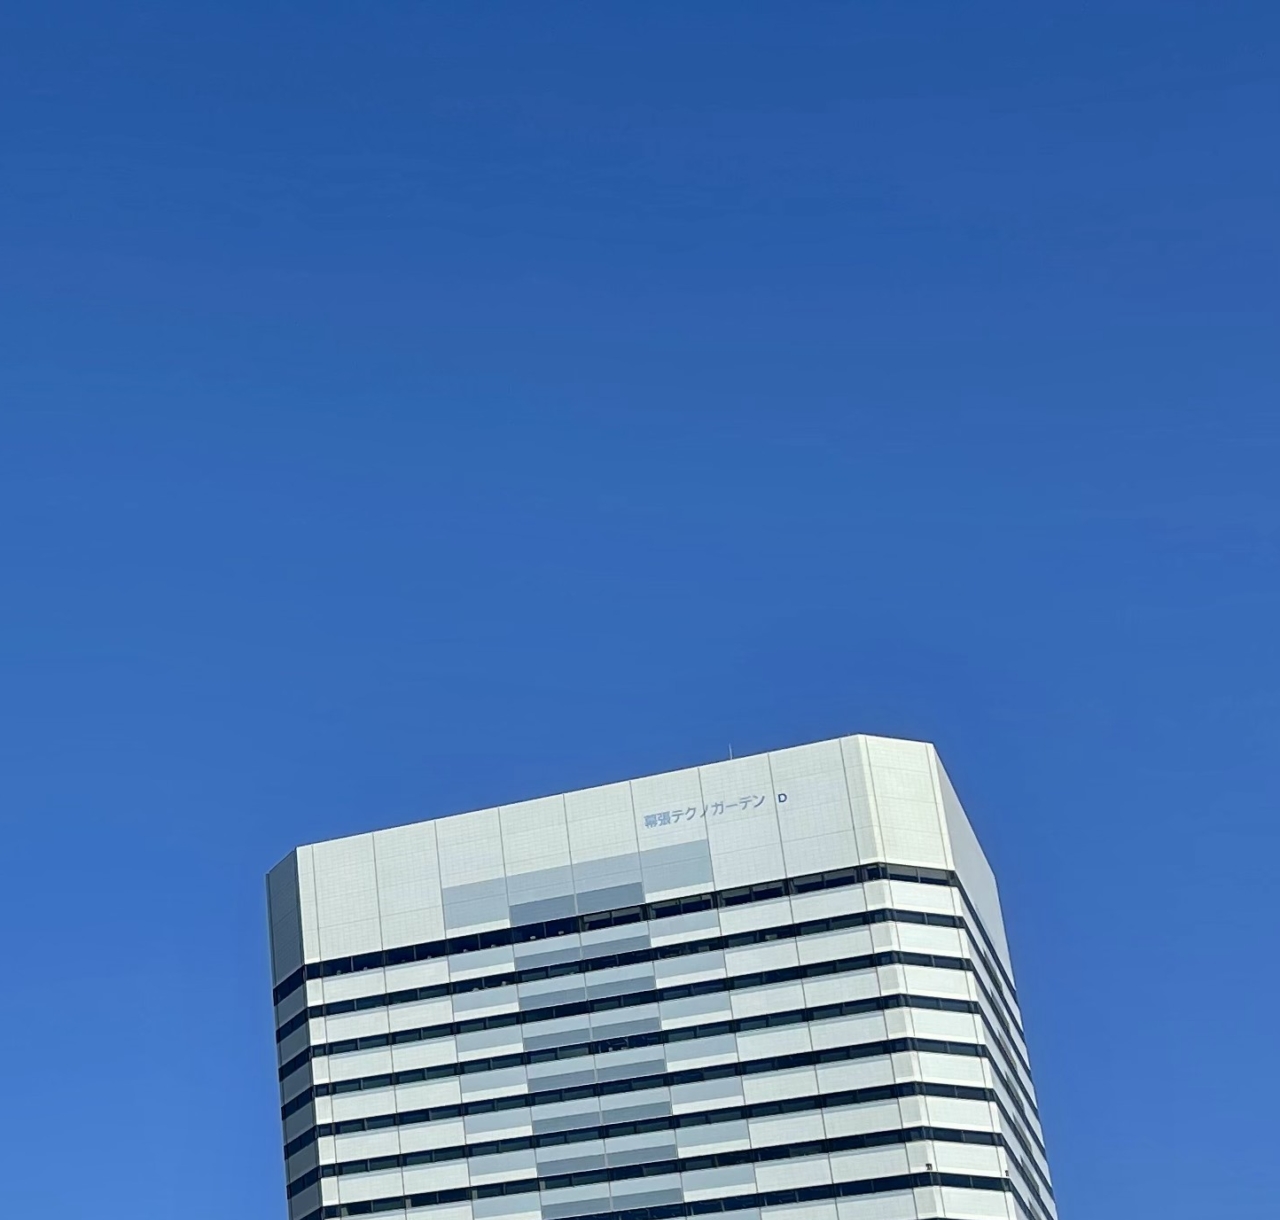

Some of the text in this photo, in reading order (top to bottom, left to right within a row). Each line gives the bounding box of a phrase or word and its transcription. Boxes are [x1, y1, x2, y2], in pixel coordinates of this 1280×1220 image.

[643, 793, 788, 829] 幕張テクノガーデン D
